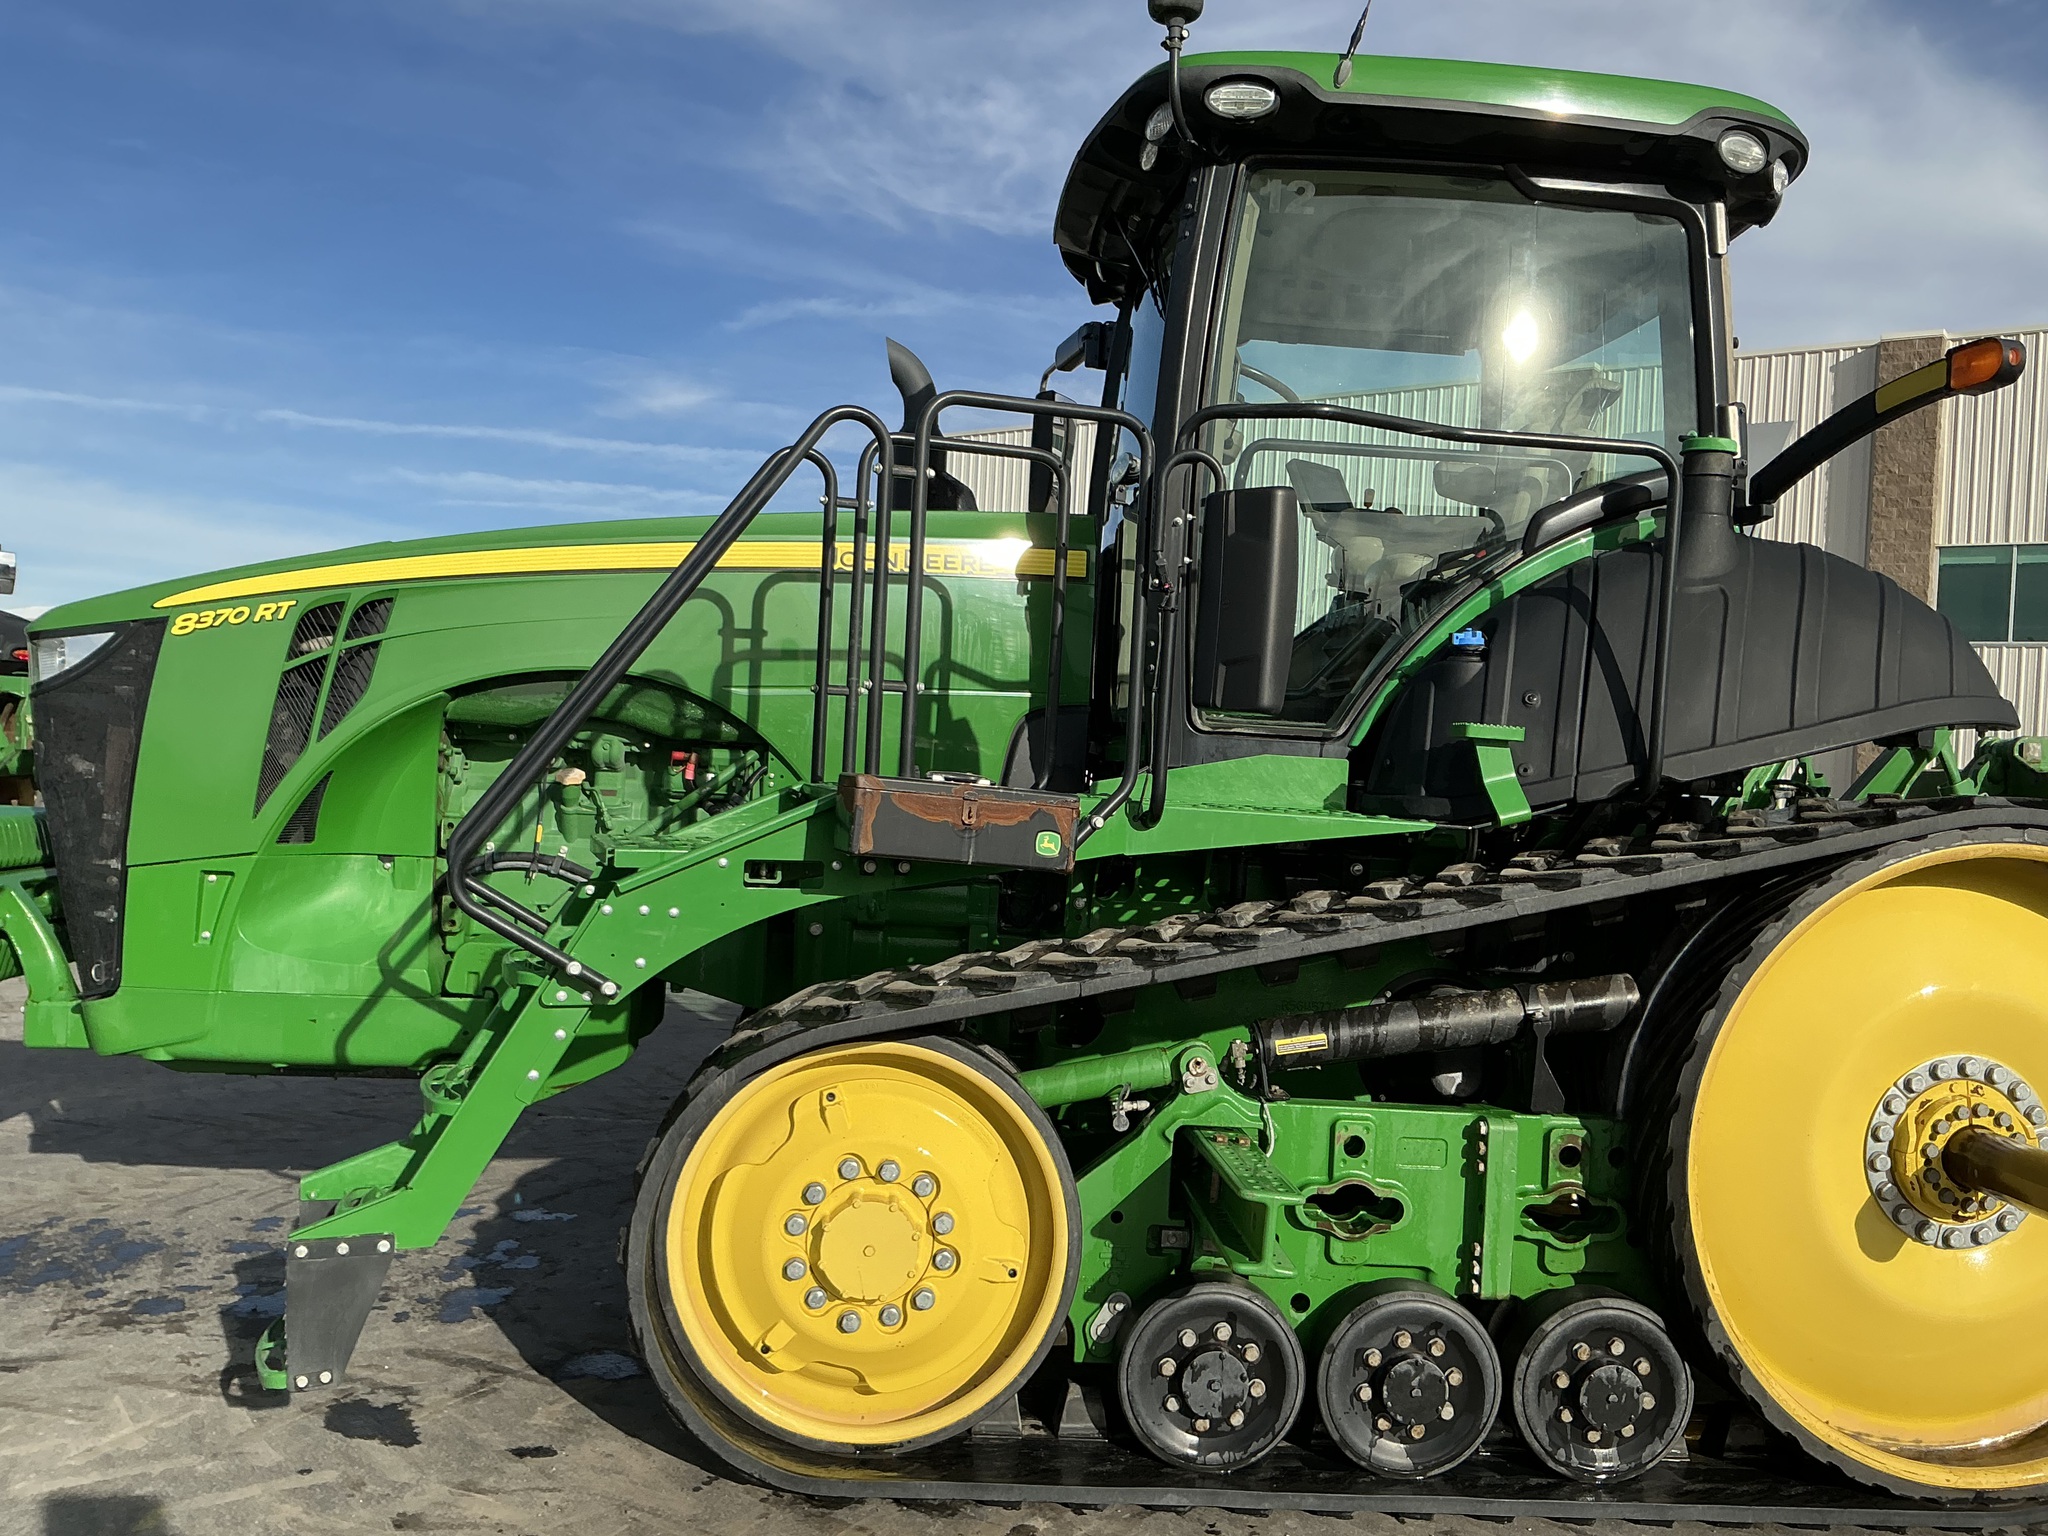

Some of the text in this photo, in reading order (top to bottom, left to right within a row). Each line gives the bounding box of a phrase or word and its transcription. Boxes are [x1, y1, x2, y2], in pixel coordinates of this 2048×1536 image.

[1260, 179, 1316, 214] 12
[834, 547, 899, 569] JON
[170, 600, 297, 636] 8370 RT
